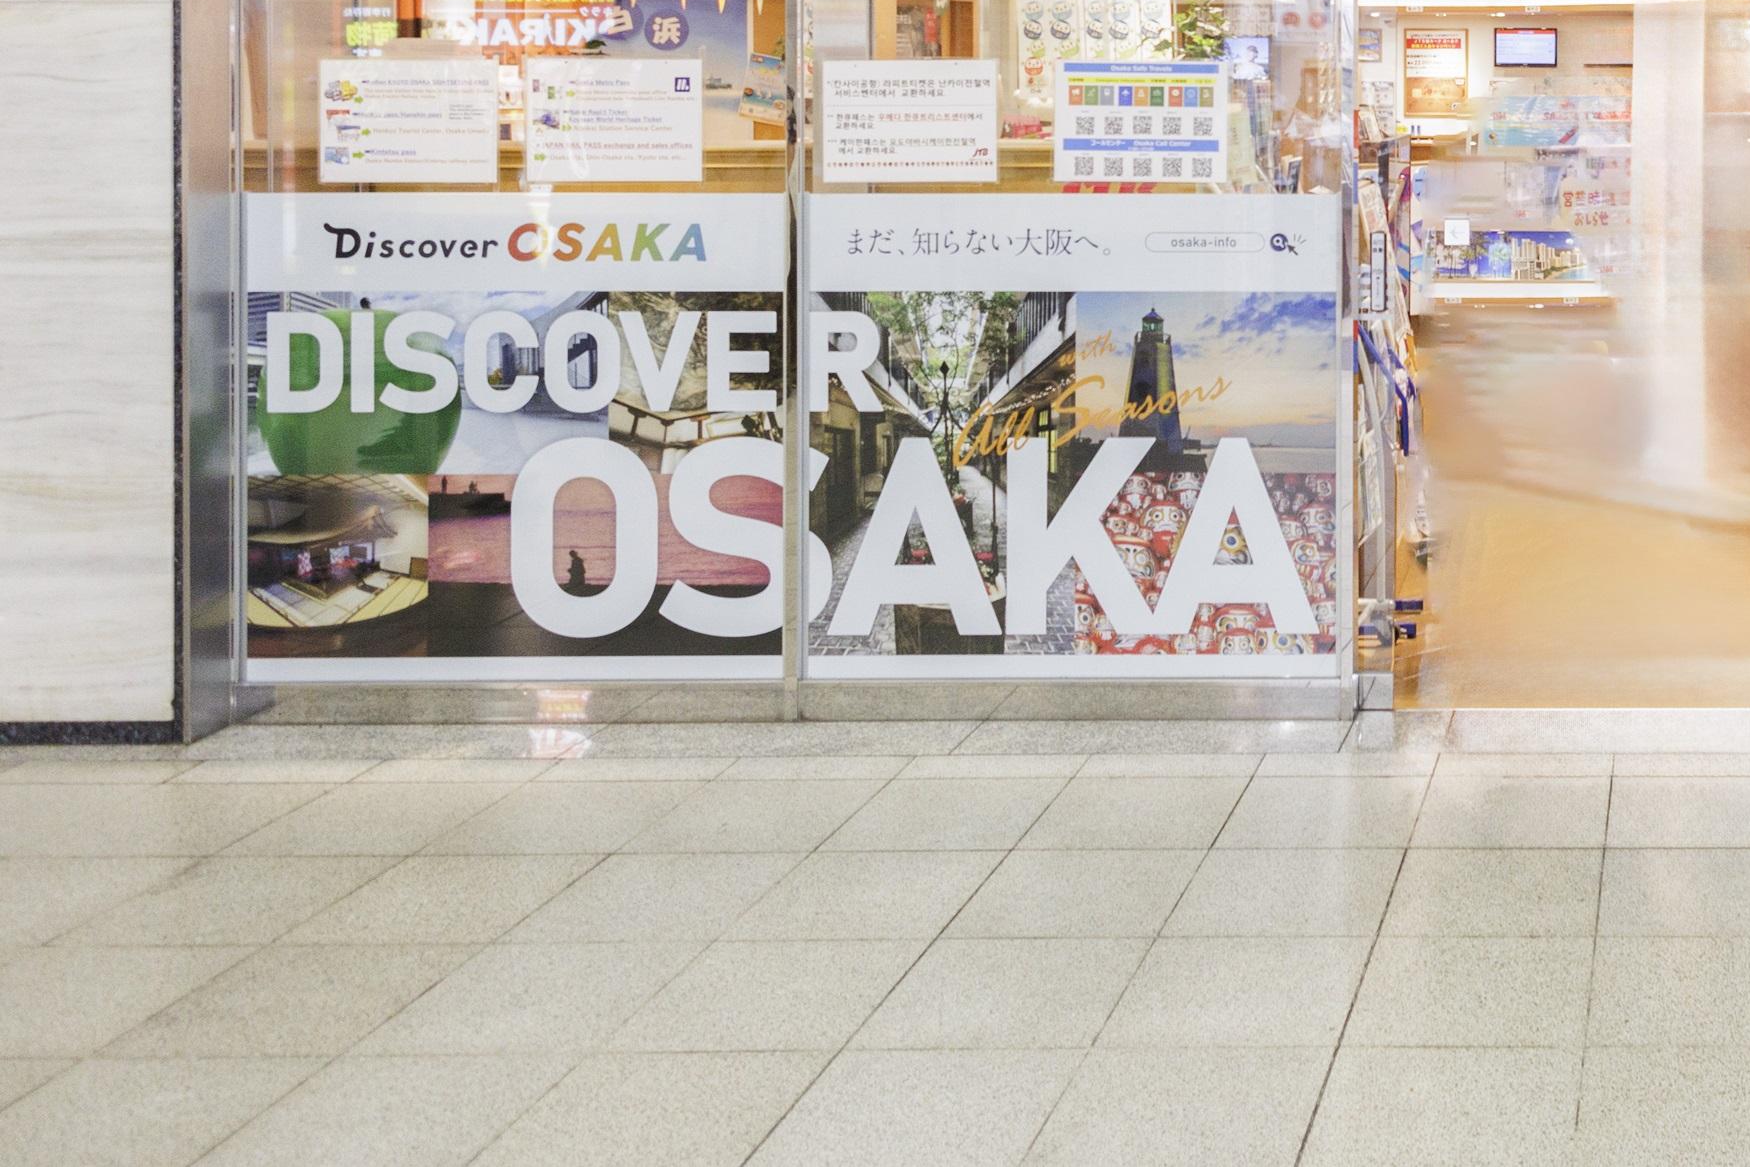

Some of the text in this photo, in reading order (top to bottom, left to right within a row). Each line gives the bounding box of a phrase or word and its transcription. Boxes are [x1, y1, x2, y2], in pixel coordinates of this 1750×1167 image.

[972, 147, 989, 158] JTB
[323, 222, 707, 263] Discover OSAKA
[845, 228, 1113, 257] まだ、知らない大阪へ。
[1170, 235, 1237, 249] osaka-info
[266, 310, 883, 414] DISCOVER
[1048, 373, 1233, 449] Seasons
[511, 436, 1321, 638] OSAKA
